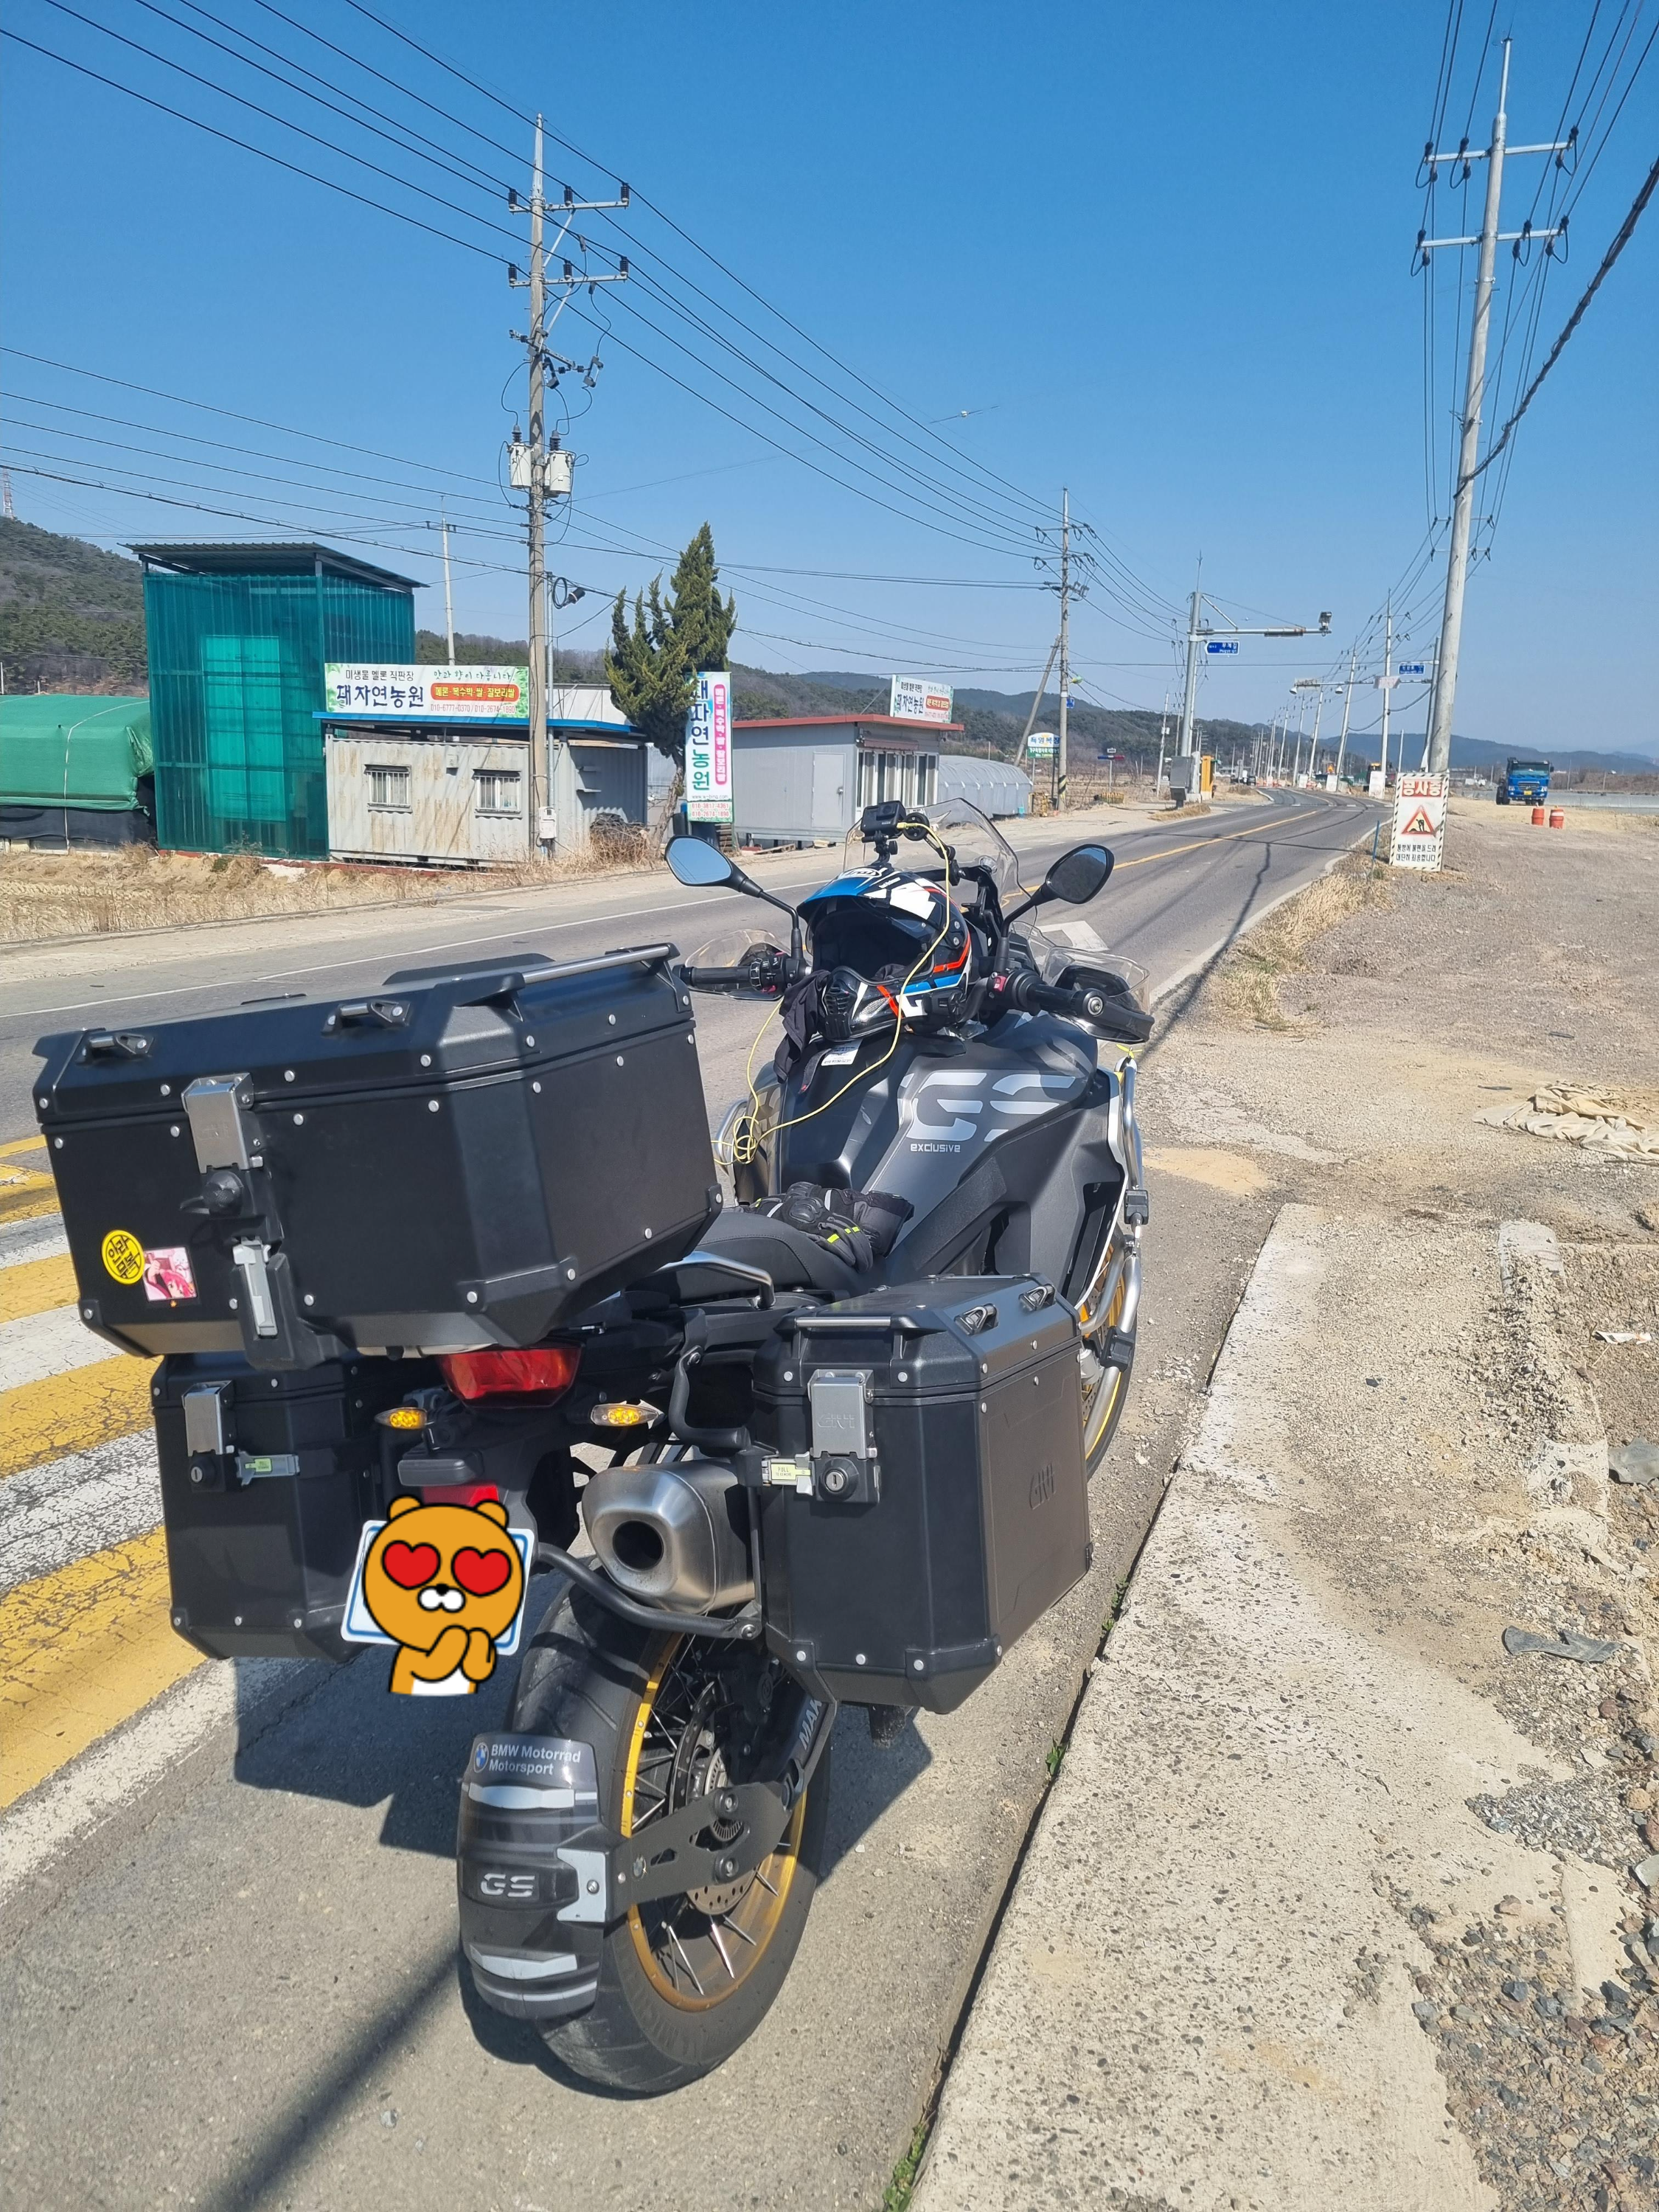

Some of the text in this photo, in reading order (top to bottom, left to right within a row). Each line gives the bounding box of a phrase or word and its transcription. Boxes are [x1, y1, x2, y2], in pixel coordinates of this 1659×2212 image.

[346, 669, 414, 681] 미생물 멜론 직판장
[336, 684, 424, 709] 대자연농원
[1402, 780, 1441, 796] 공사중
[900, 1072, 1076, 1142] GS
[910, 1142, 961, 1152] exclusive
[491, 1744, 581, 1763] BMW Motorrad
[489, 1759, 554, 1775] Motorsport
[480, 1873, 535, 1898] GS
